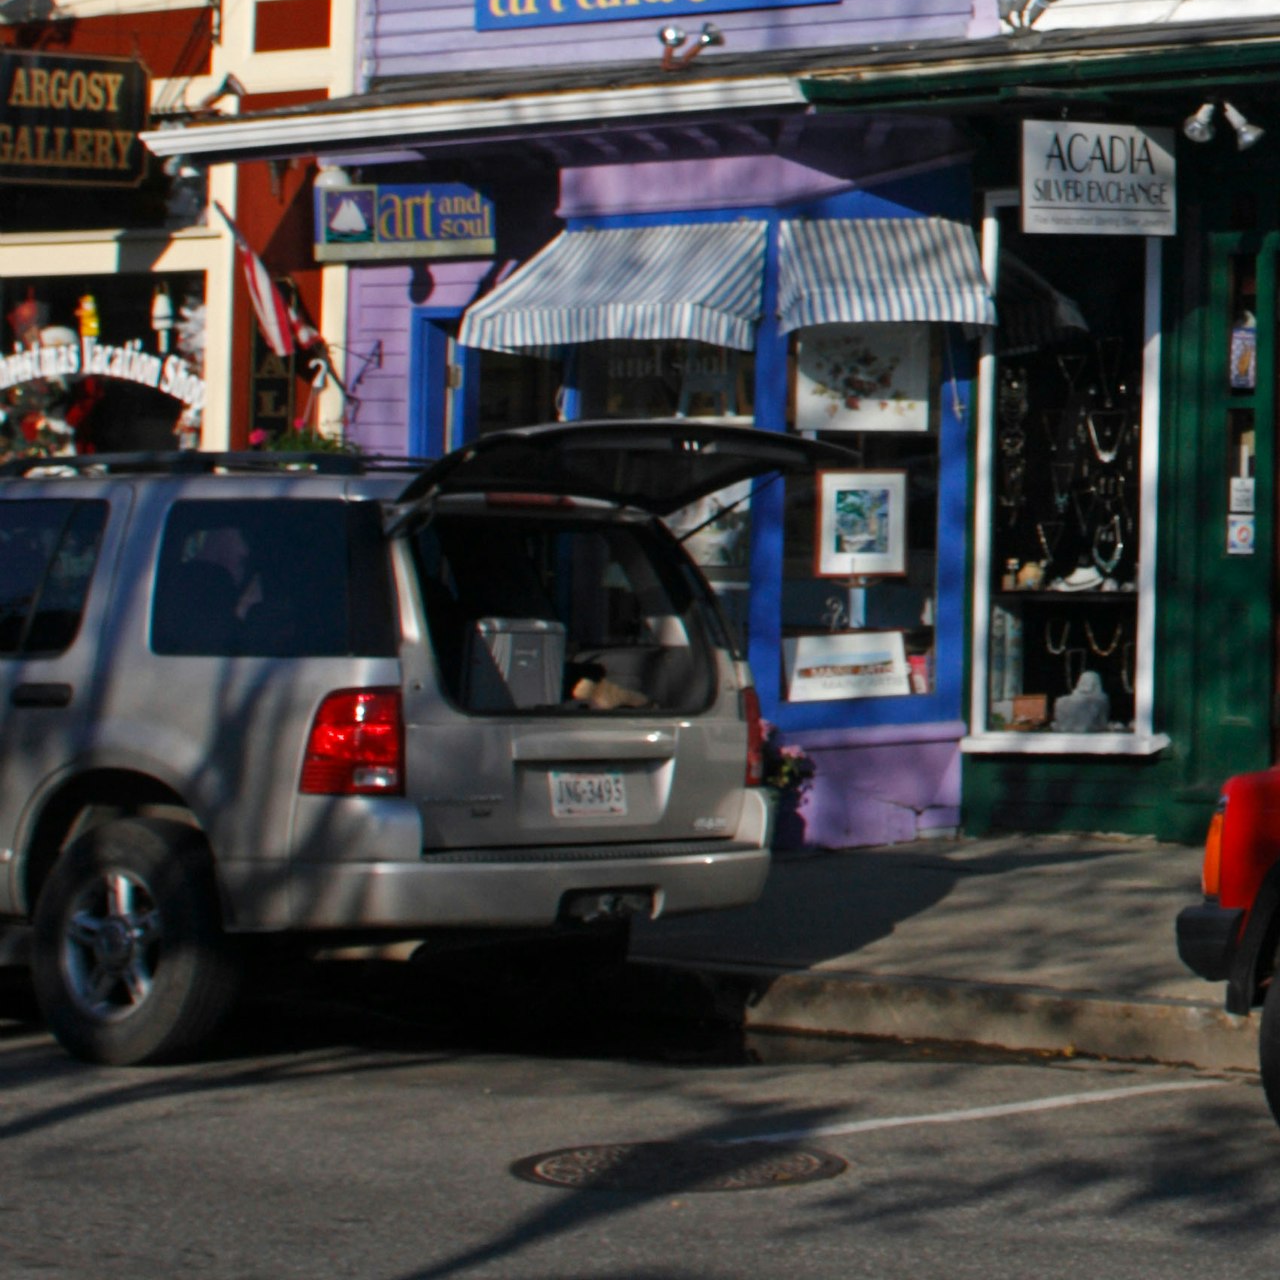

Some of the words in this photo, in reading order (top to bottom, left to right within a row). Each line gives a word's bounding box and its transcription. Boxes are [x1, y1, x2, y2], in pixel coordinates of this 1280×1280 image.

[8, 68, 124, 111] ARGOSY
[0, 124, 134, 169] GALLERY
[1046, 132, 1155, 175] ACADIA
[1034, 178, 1083, 203] SILVER
[1087, 180, 1167, 205] EXCHANGE
[378, 190, 435, 240] art
[439, 192, 481, 215] and
[440, 204, 492, 237] soul
[82, 336, 162, 388] Vacation
